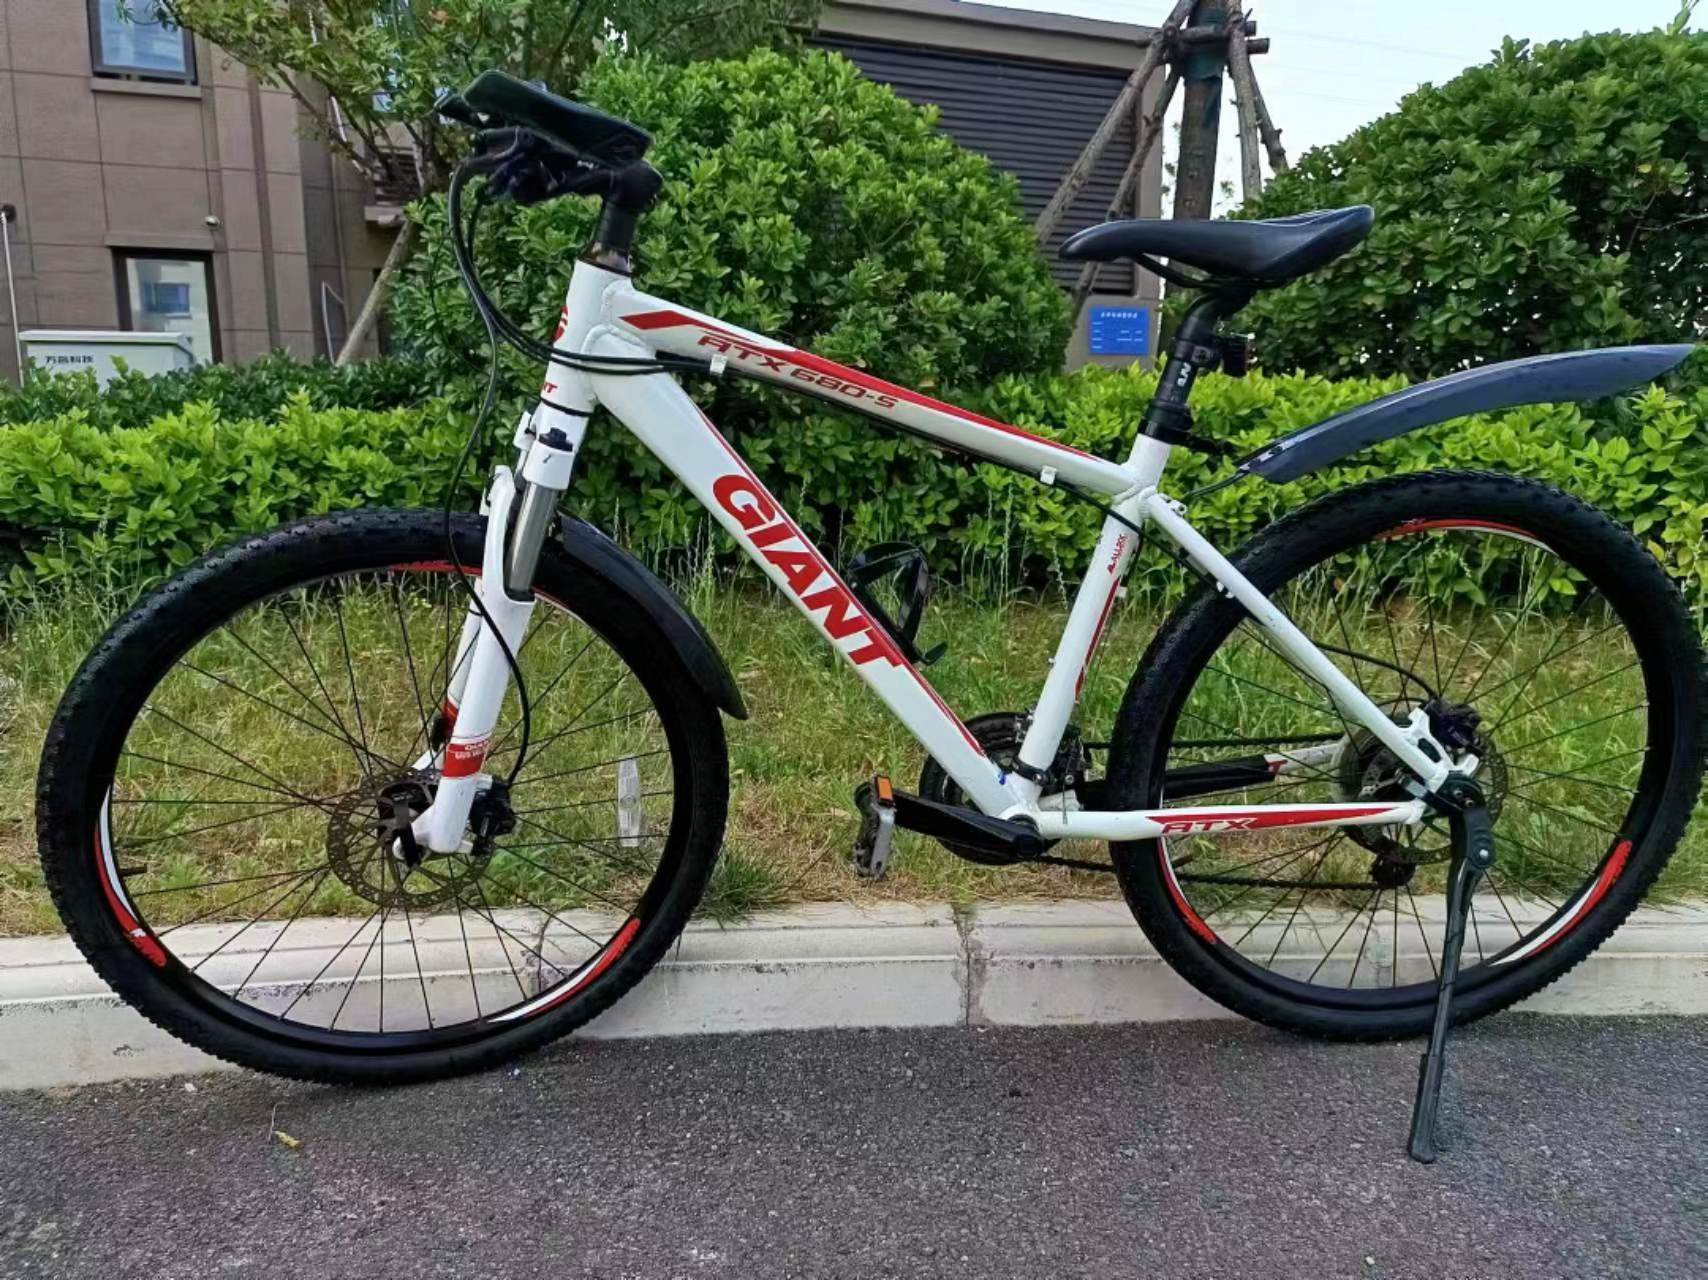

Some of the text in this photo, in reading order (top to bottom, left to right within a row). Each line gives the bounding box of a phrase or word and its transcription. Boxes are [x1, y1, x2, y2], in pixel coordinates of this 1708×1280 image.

[697, 334, 898, 409] ATX 680-S
[713, 474, 904, 668] GIANT
[1161, 818, 1255, 834] ATX
